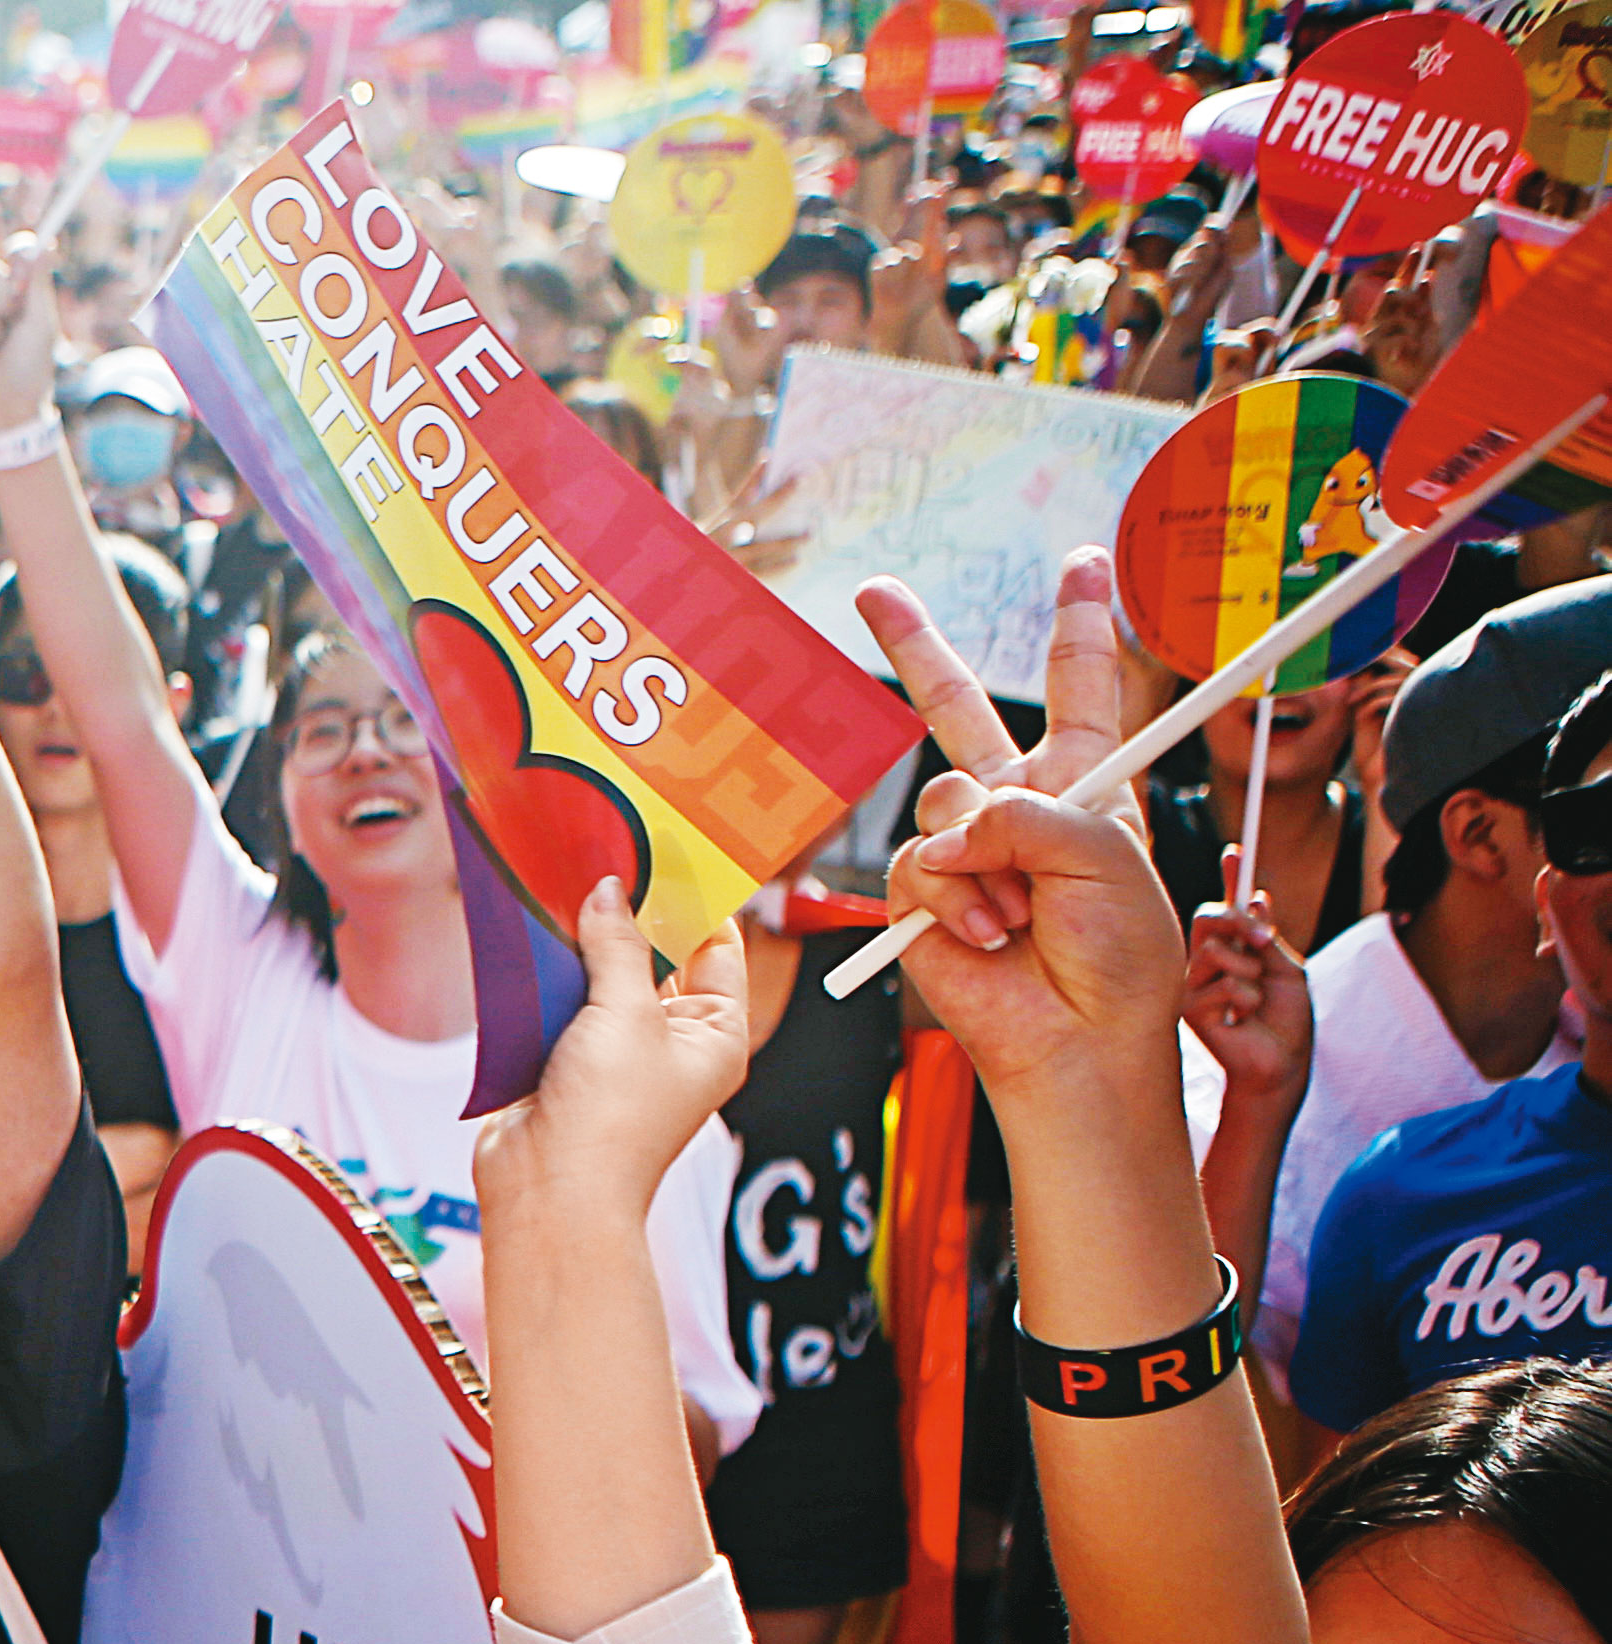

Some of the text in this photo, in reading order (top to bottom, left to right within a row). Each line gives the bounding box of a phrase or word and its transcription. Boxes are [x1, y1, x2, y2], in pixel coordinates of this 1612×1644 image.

[303, 120, 523, 420] LOVE
[1265, 77, 1403, 170] FREE
[1383, 108, 1511, 196] HUG
[211, 216, 406, 523] HATE
[249, 174, 689, 747] CONQUERS
